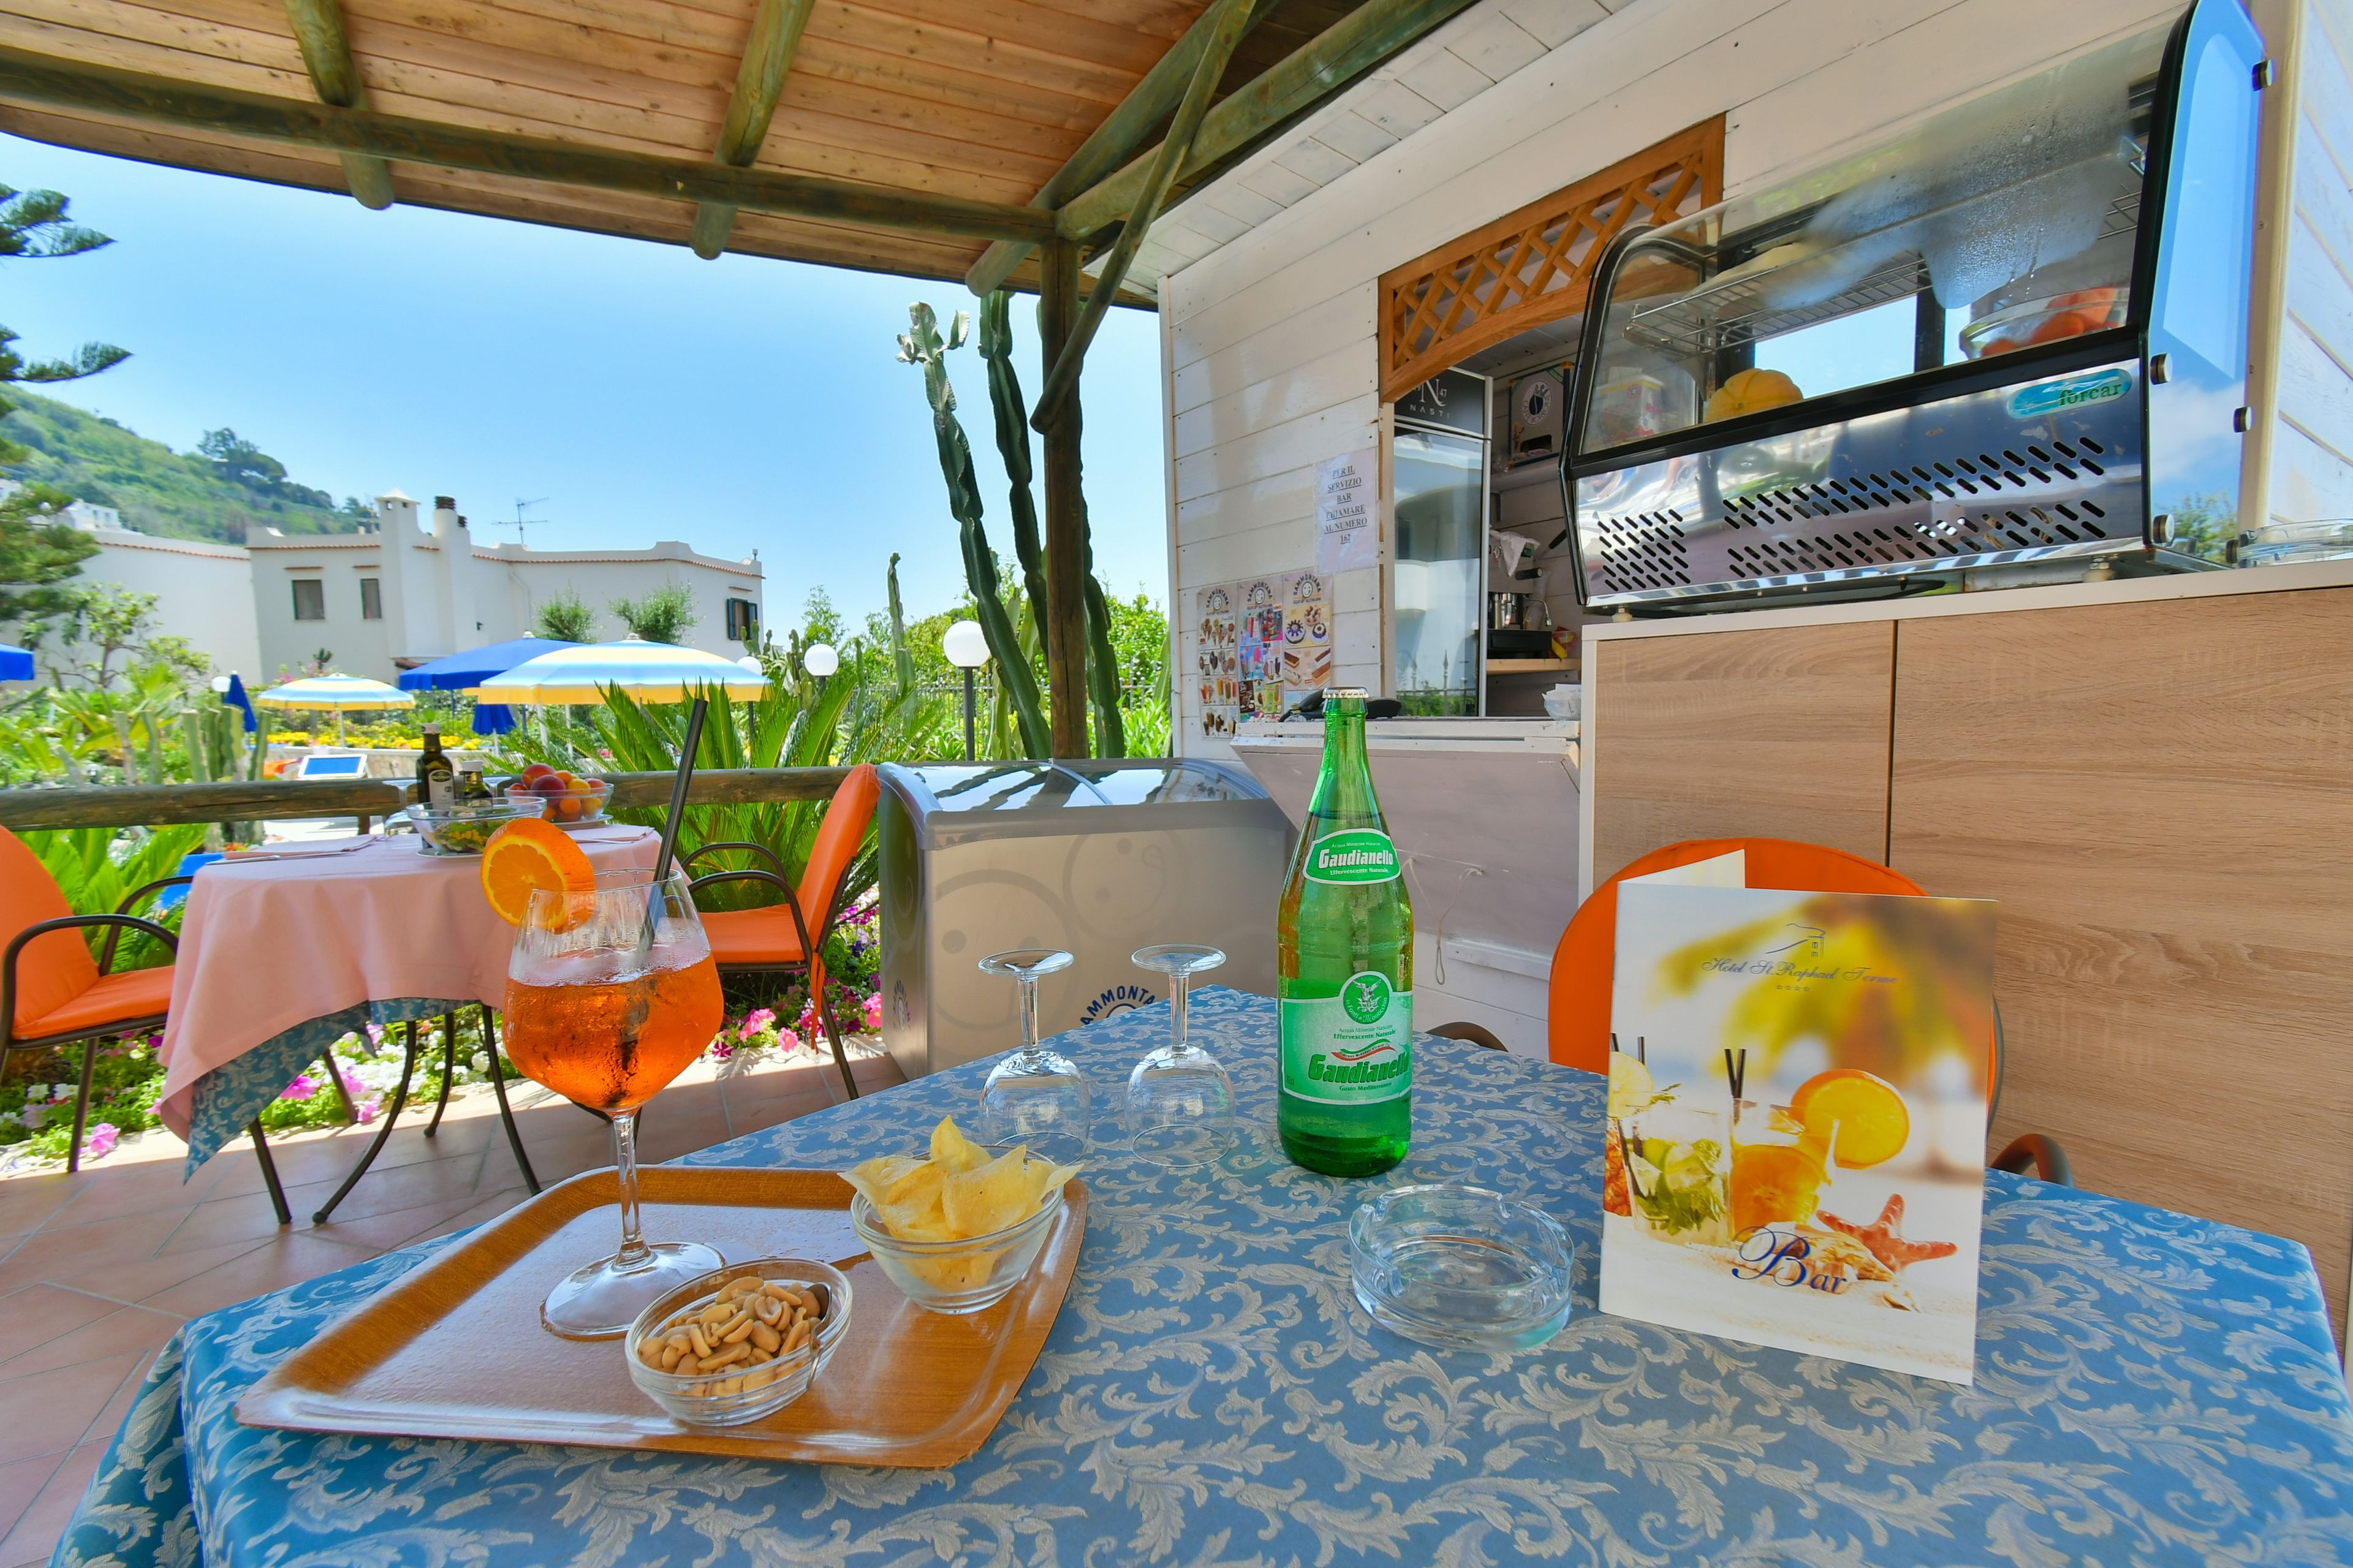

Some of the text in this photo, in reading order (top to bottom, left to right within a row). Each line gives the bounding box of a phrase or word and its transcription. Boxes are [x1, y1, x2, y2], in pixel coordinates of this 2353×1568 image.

[2059, 383, 2122, 406] forcar
[1332, 465, 1355, 478] PER IL
[1328, 477, 1362, 493] SERVIZIO
[1336, 492, 1352, 503] BAR
[1326, 504, 1365, 520] CHIAMARE
[1324, 517, 1368, 533] AL NUMERO
[1293, 574, 1321, 596] SAMMONTANA
[1318, 849, 1393, 869] Gaudianello
[1701, 958, 1748, 973] Hotel
[1843, 966, 1898, 983] Terme
[1080, 985, 1156, 1025] AMMONTA
[1376, 1029, 1396, 1038] Naturale
[1308, 1051, 1409, 1084] Gaudianello
[1357, 1082, 1392, 1091] Mediterraneo
[1732, 1226, 1847, 1293] Bar
